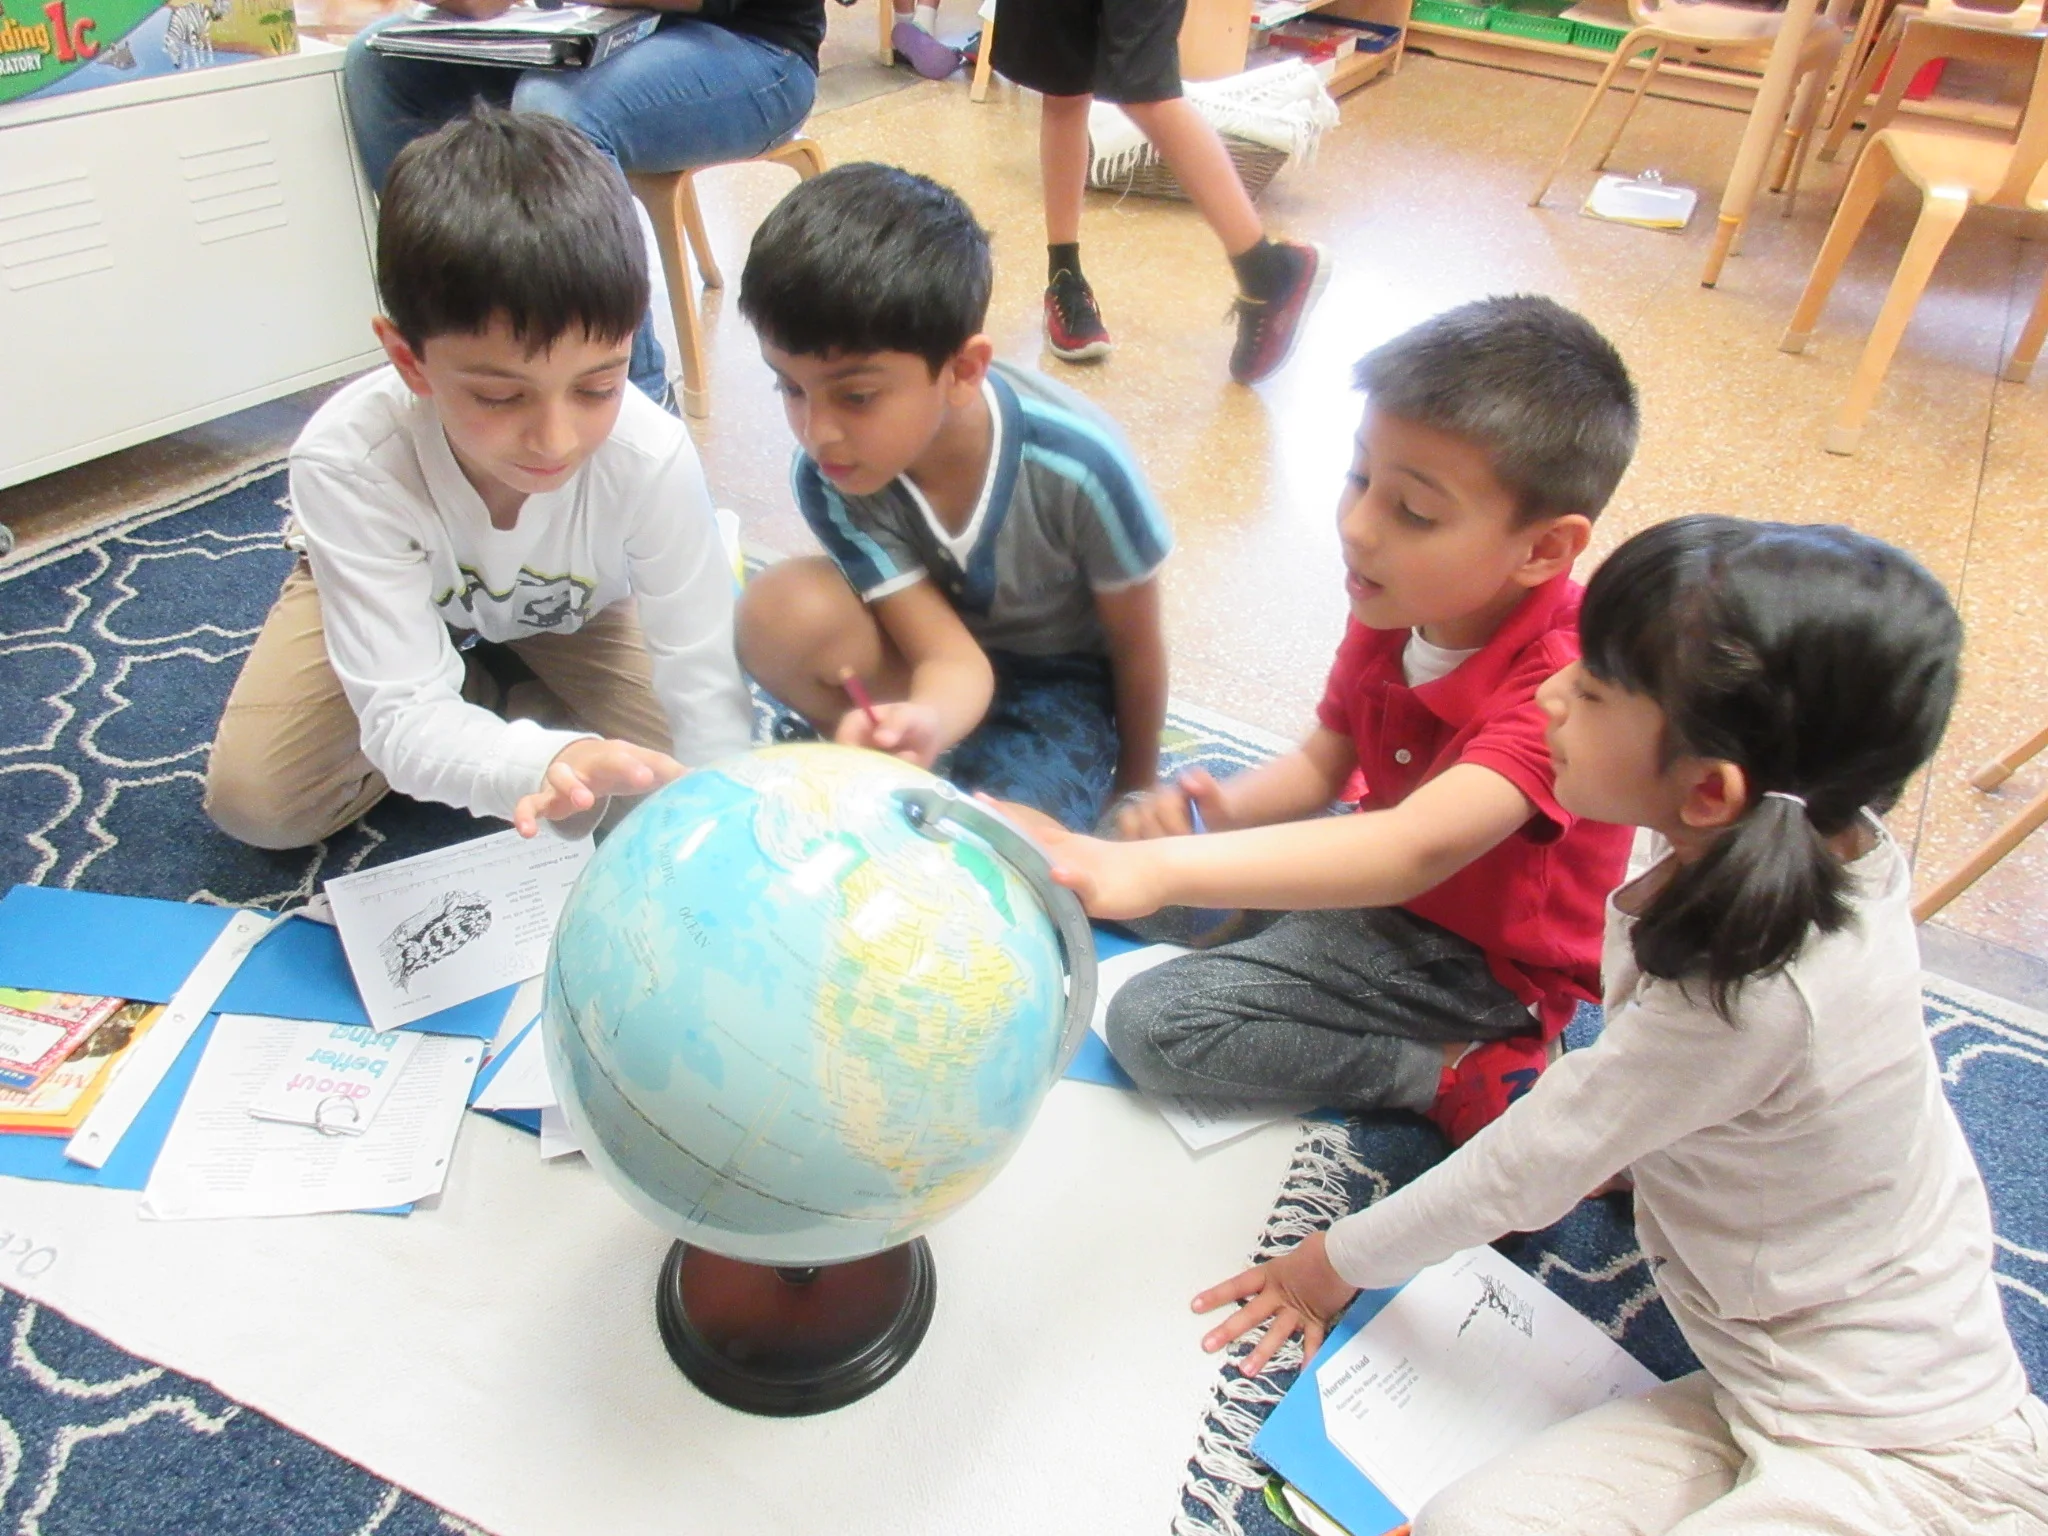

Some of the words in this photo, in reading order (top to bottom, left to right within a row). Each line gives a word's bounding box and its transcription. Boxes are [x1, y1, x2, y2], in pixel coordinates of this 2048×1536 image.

[0, 18, 50, 54] ding
[657, 842, 677, 887] PACIFIC
[678, 906, 713, 949] OCEAN
[306, 1048, 390, 1079] better
[286, 1073, 371, 1099] about
[1323, 1369, 1352, 1398] Horned
[1350, 1354, 1370, 1373] Toad
